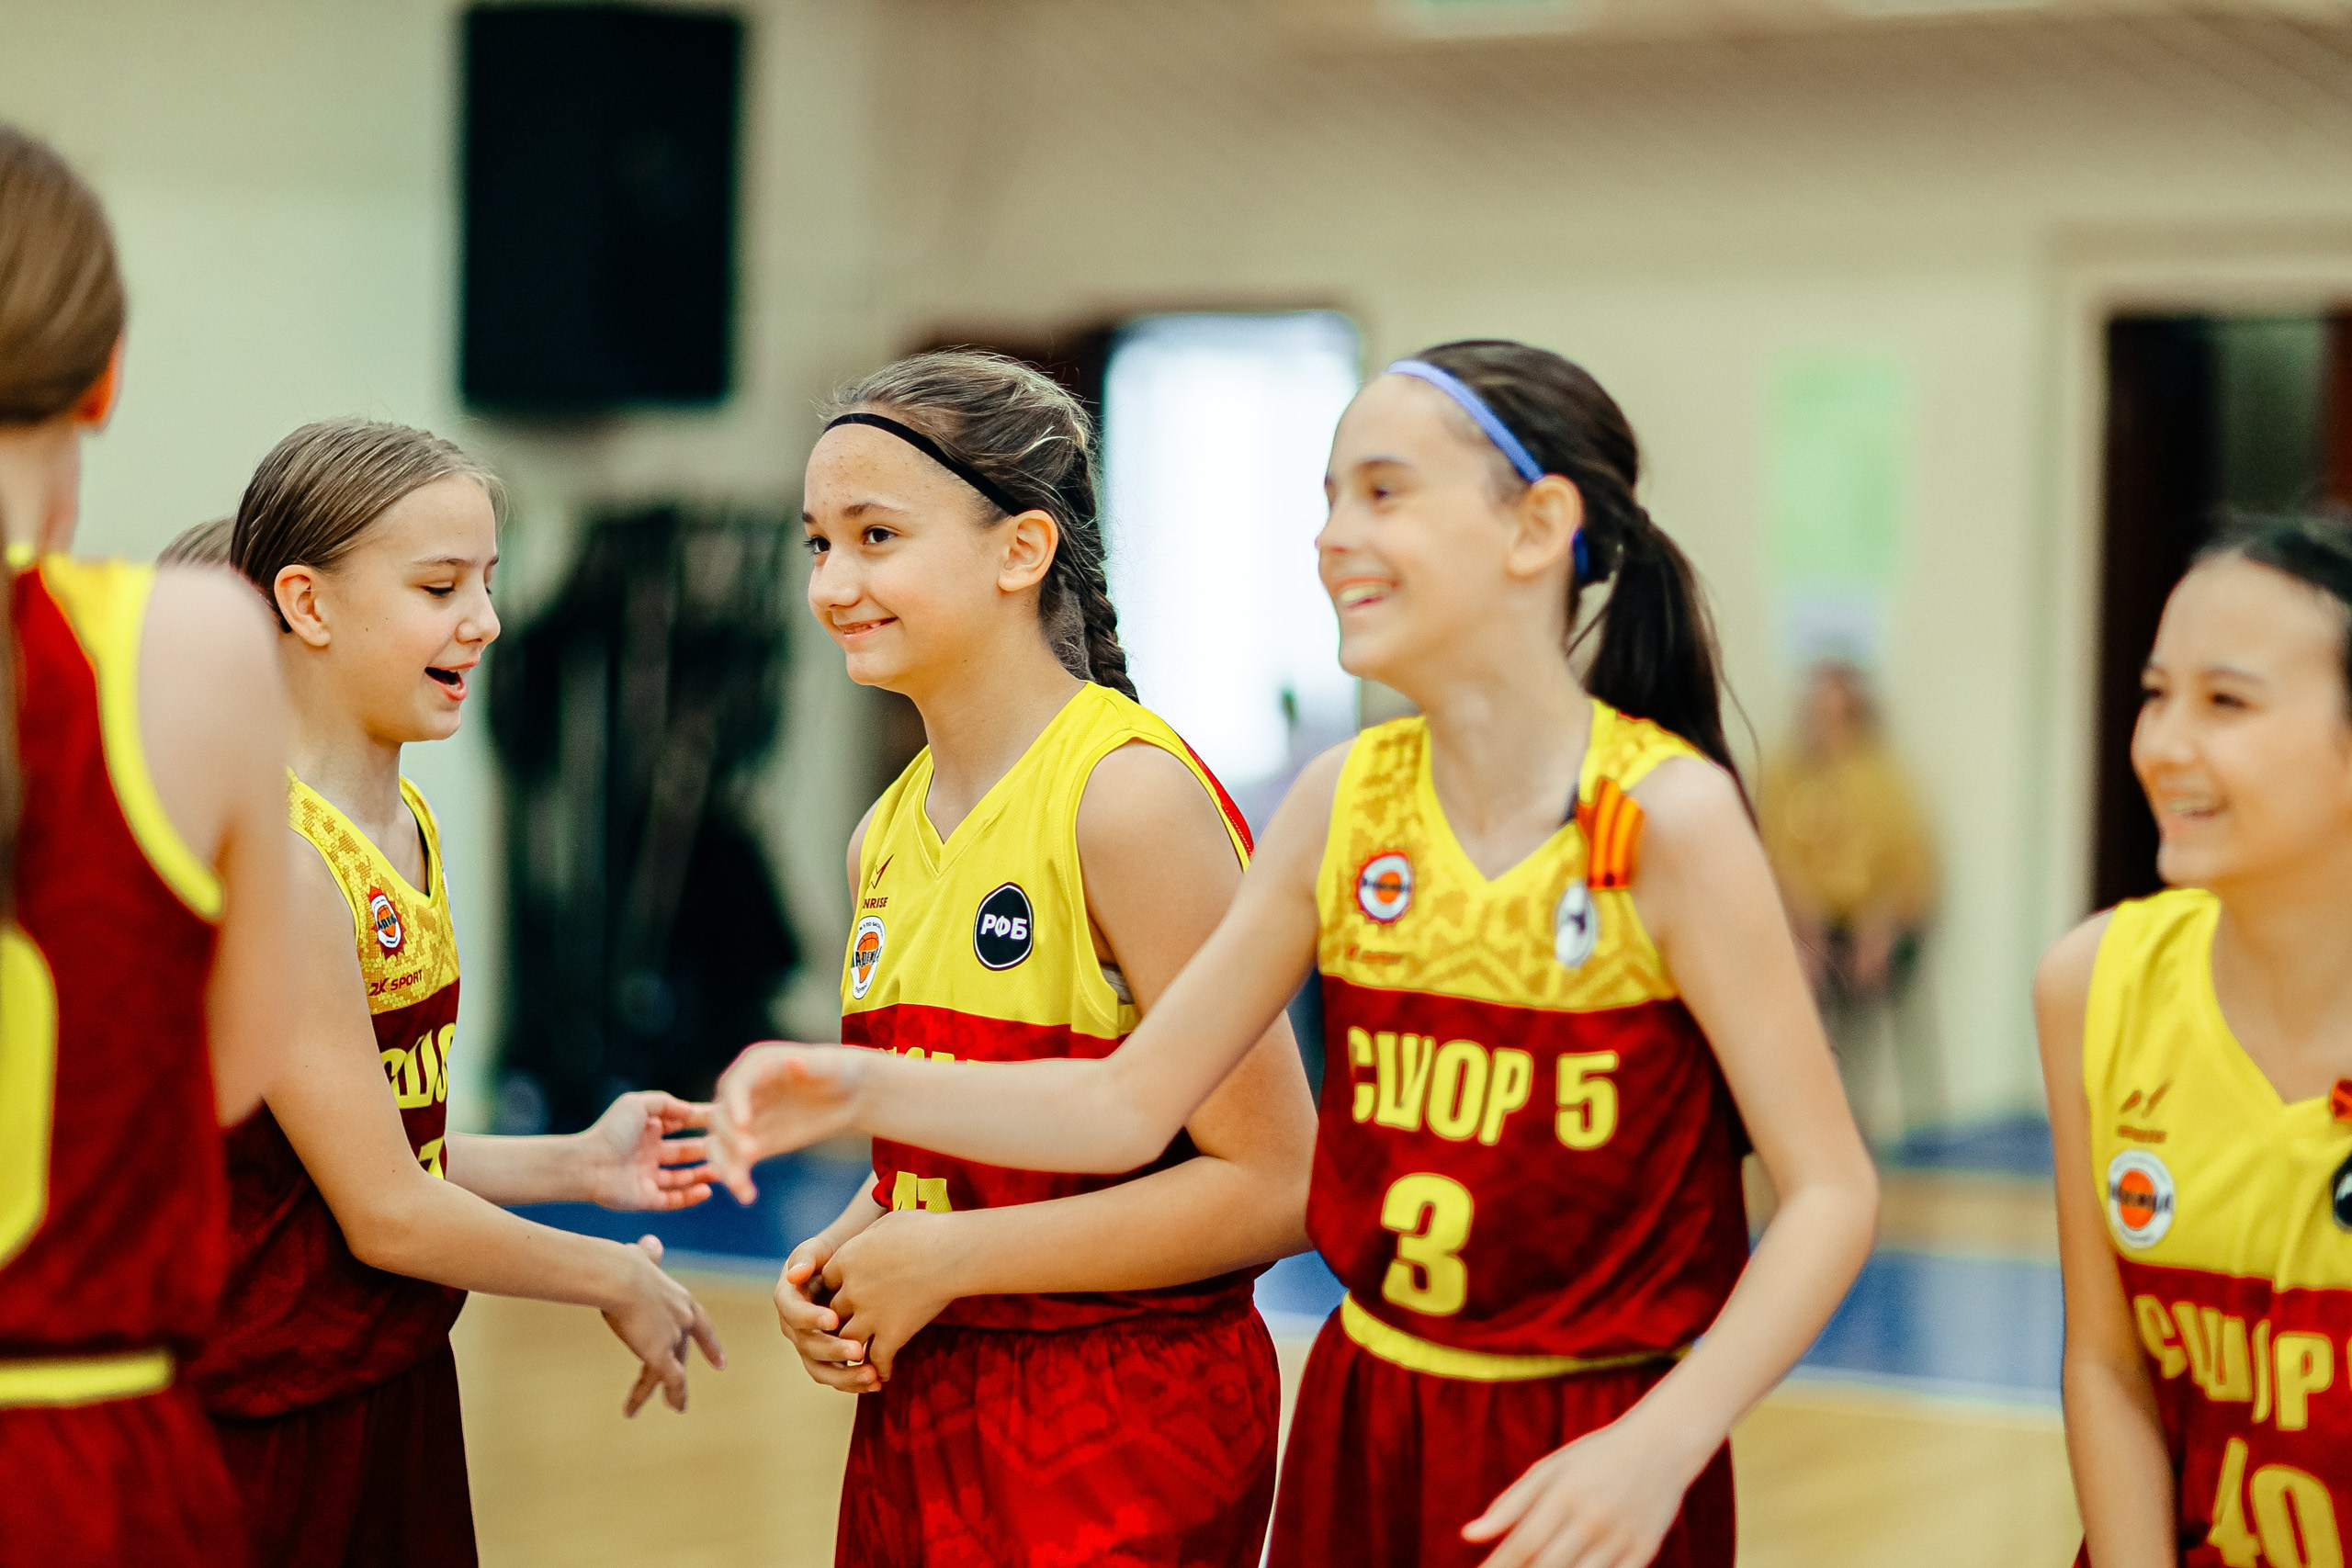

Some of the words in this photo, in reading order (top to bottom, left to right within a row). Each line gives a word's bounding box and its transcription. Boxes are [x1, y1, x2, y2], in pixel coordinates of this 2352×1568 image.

[390, 969, 423, 991] SPORT
[980, 913, 1028, 942] РФБ
[1348, 1025, 1532, 1145] СШОР
[1555, 1050, 1619, 1150] 5
[1381, 1172, 1475, 1317] 3
[2207, 1435, 2345, 1568] 40
